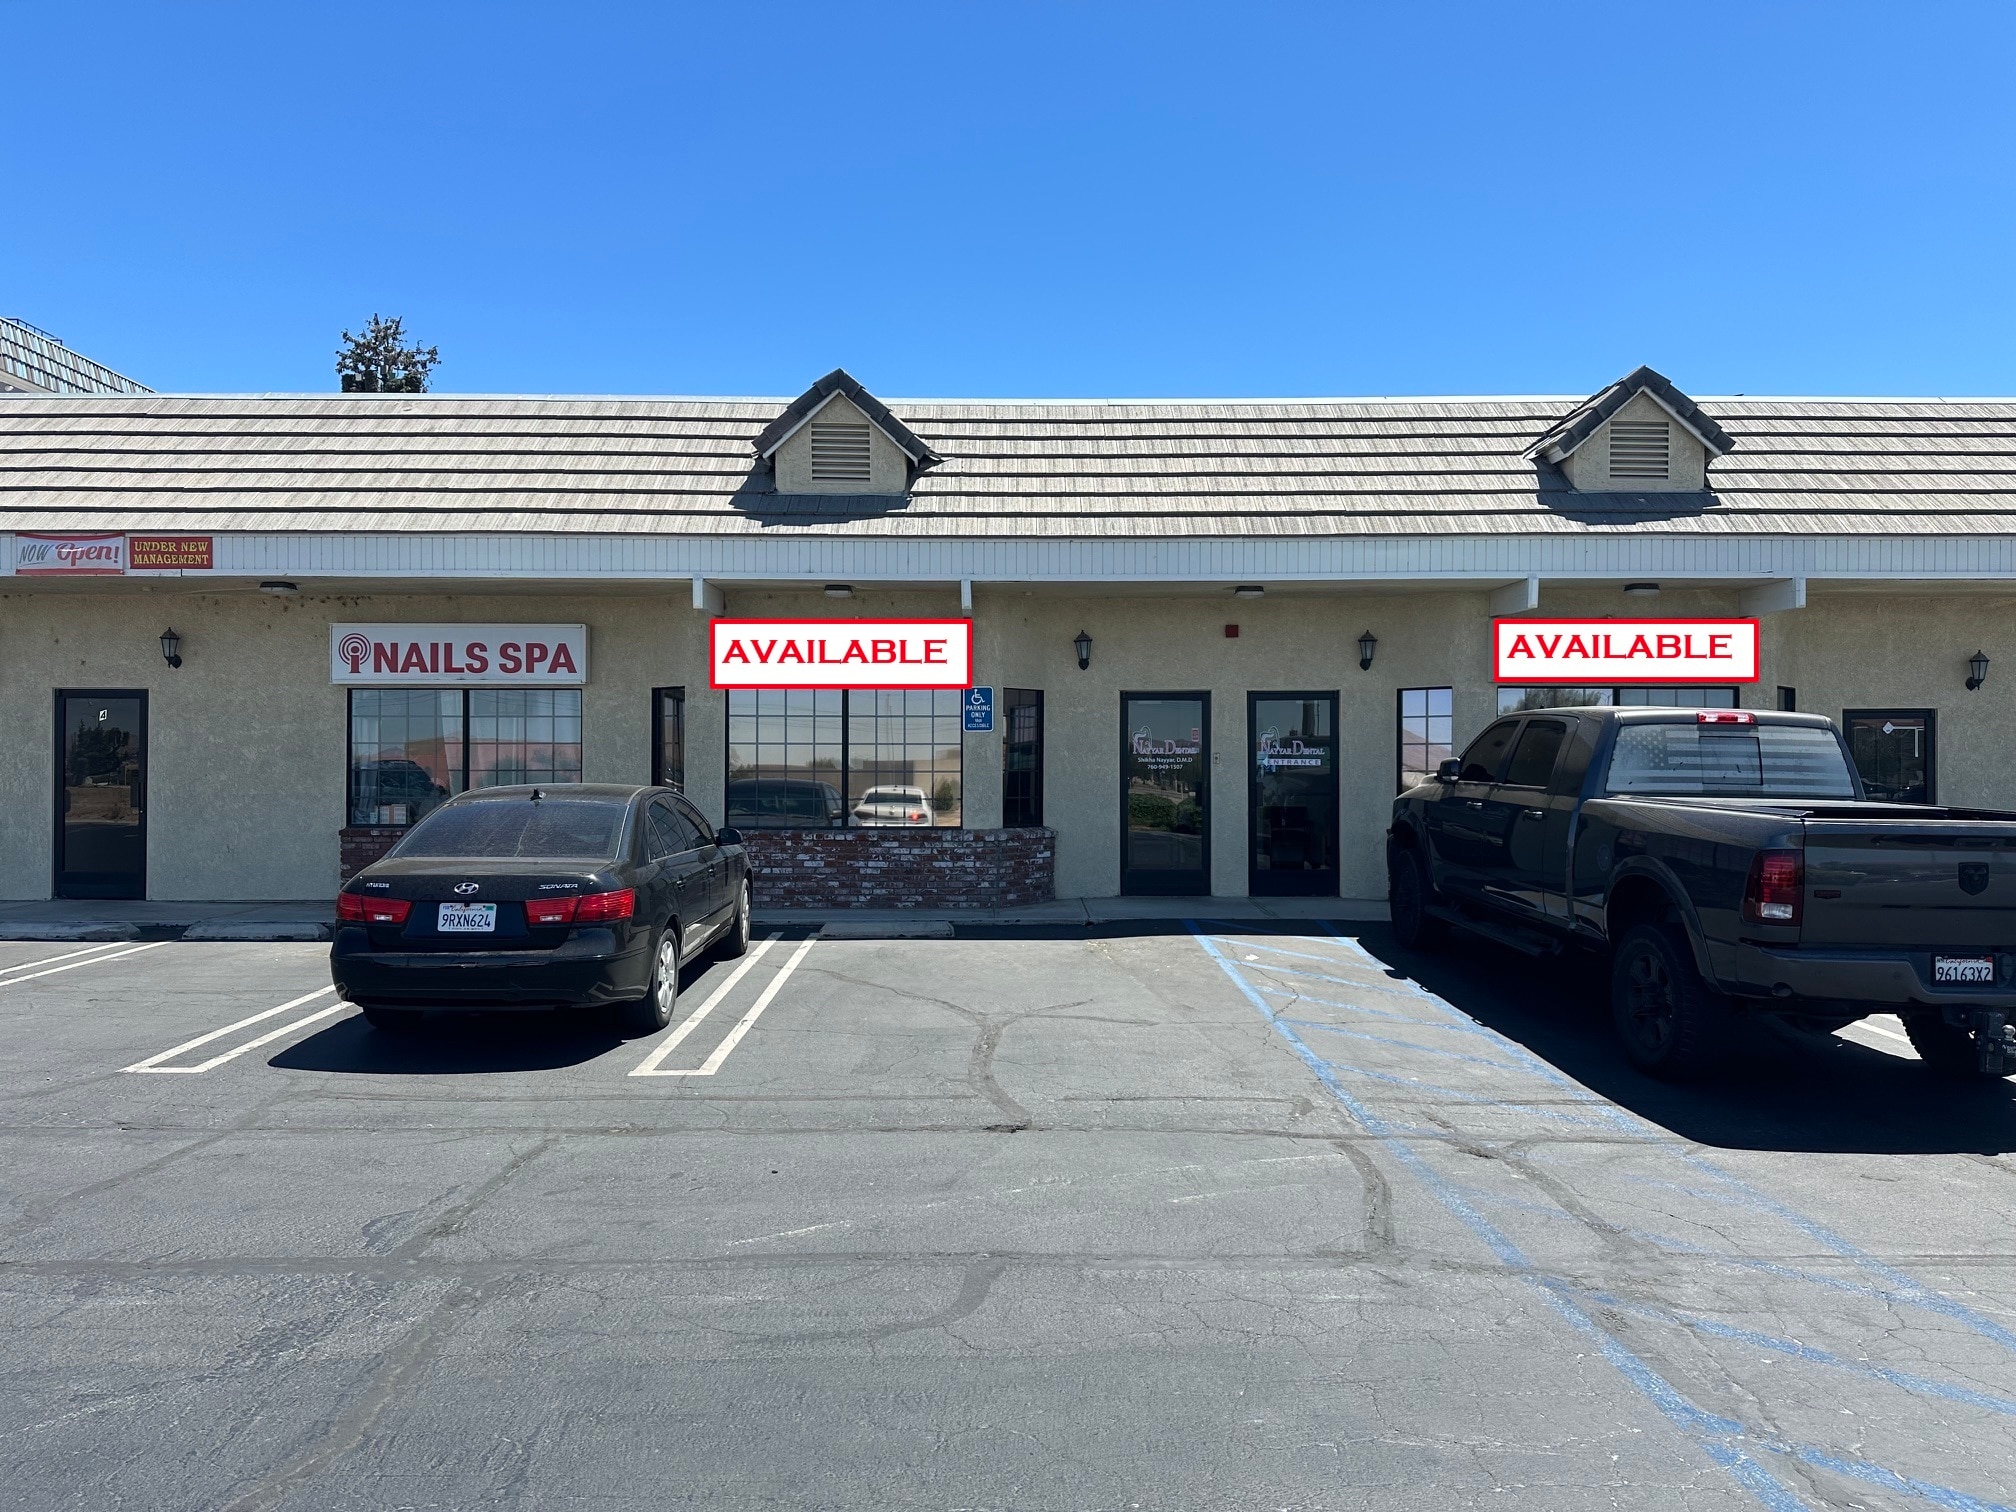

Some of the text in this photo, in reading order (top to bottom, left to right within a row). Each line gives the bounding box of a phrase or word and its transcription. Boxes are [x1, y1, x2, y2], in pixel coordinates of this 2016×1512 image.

[134, 541, 209, 552] UNDER NEW
[18, 542, 119, 567] NOW Open!
[133, 554, 209, 565] MANAGEMENT
[498, 642, 578, 674] SPA
[441, 913, 491, 928] 9RXN624
[1937, 966, 1991, 981] 96163X2
